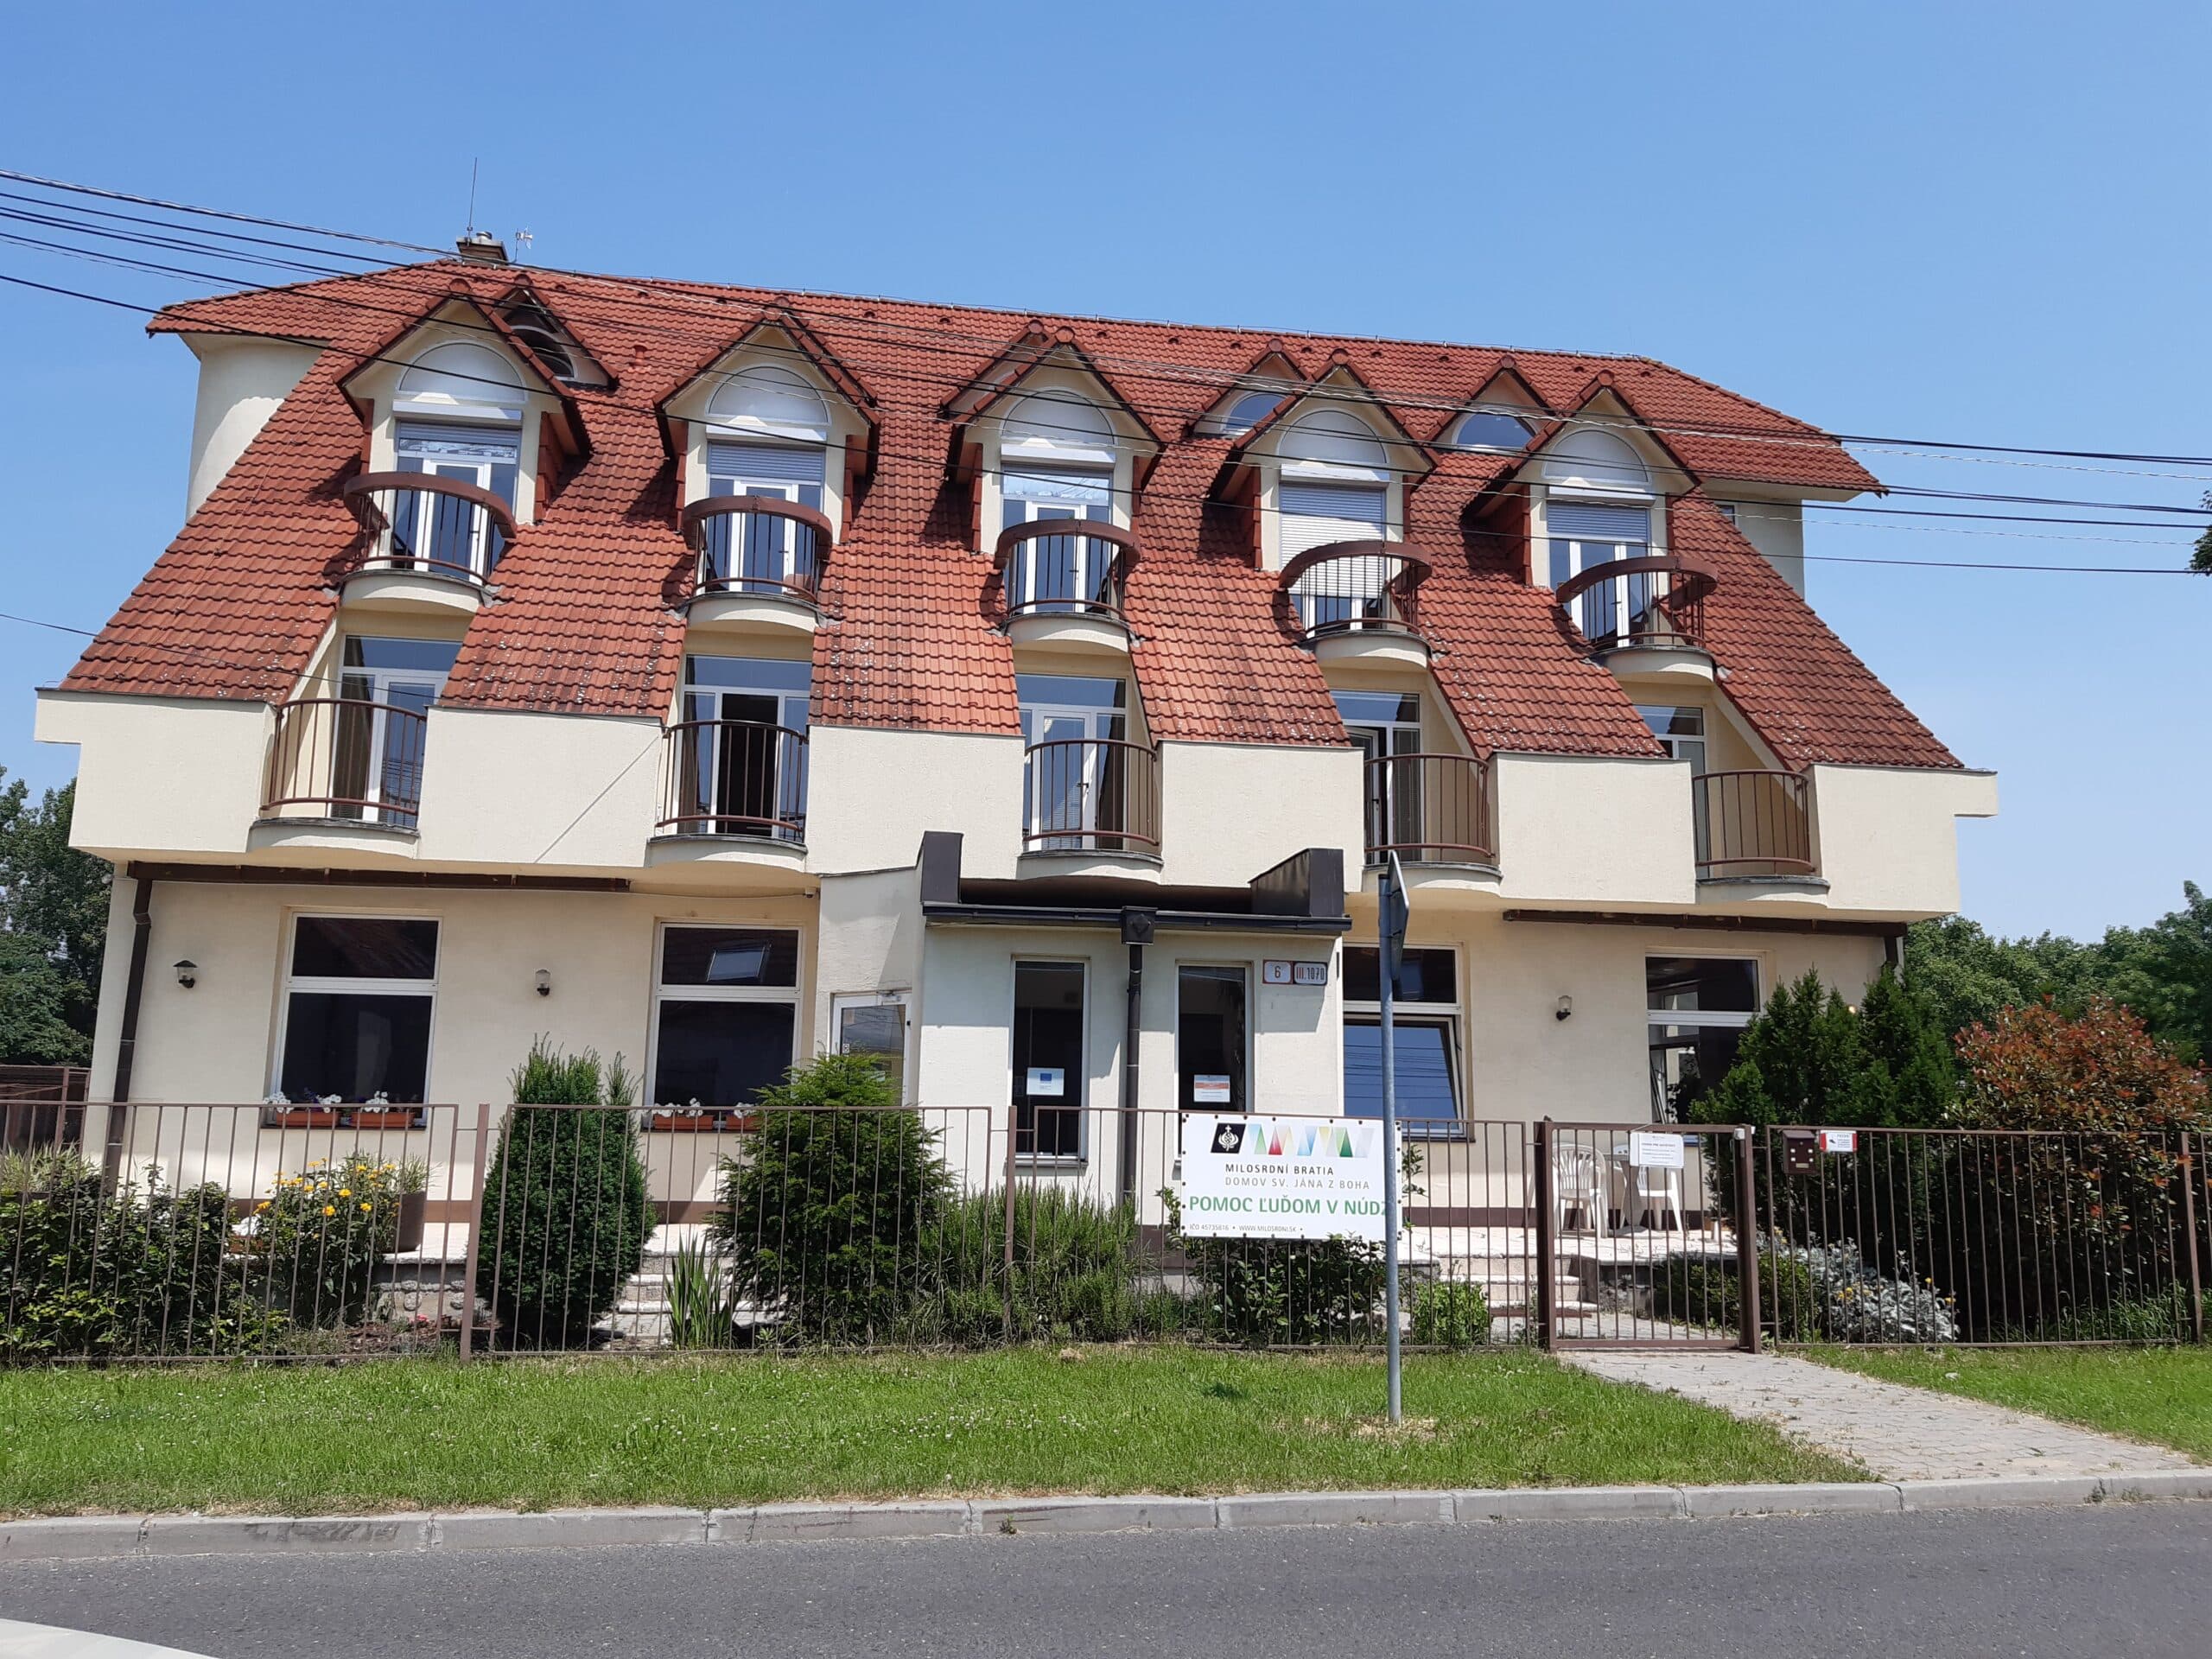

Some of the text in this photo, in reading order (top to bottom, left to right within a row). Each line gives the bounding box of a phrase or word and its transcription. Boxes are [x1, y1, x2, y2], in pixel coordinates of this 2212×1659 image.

[1274, 965, 1281, 978] 6
[1225, 1163, 1334, 1175] MILOSRDNÍ BRATIA
[1225, 1176, 1370, 1190] DOMOV SV. JÁNA Z BOHA
[1189, 1196, 1253, 1212] POMOC
[1259, 1194, 1320, 1214] ĽUĎOM
[1326, 1199, 1338, 1215] V
